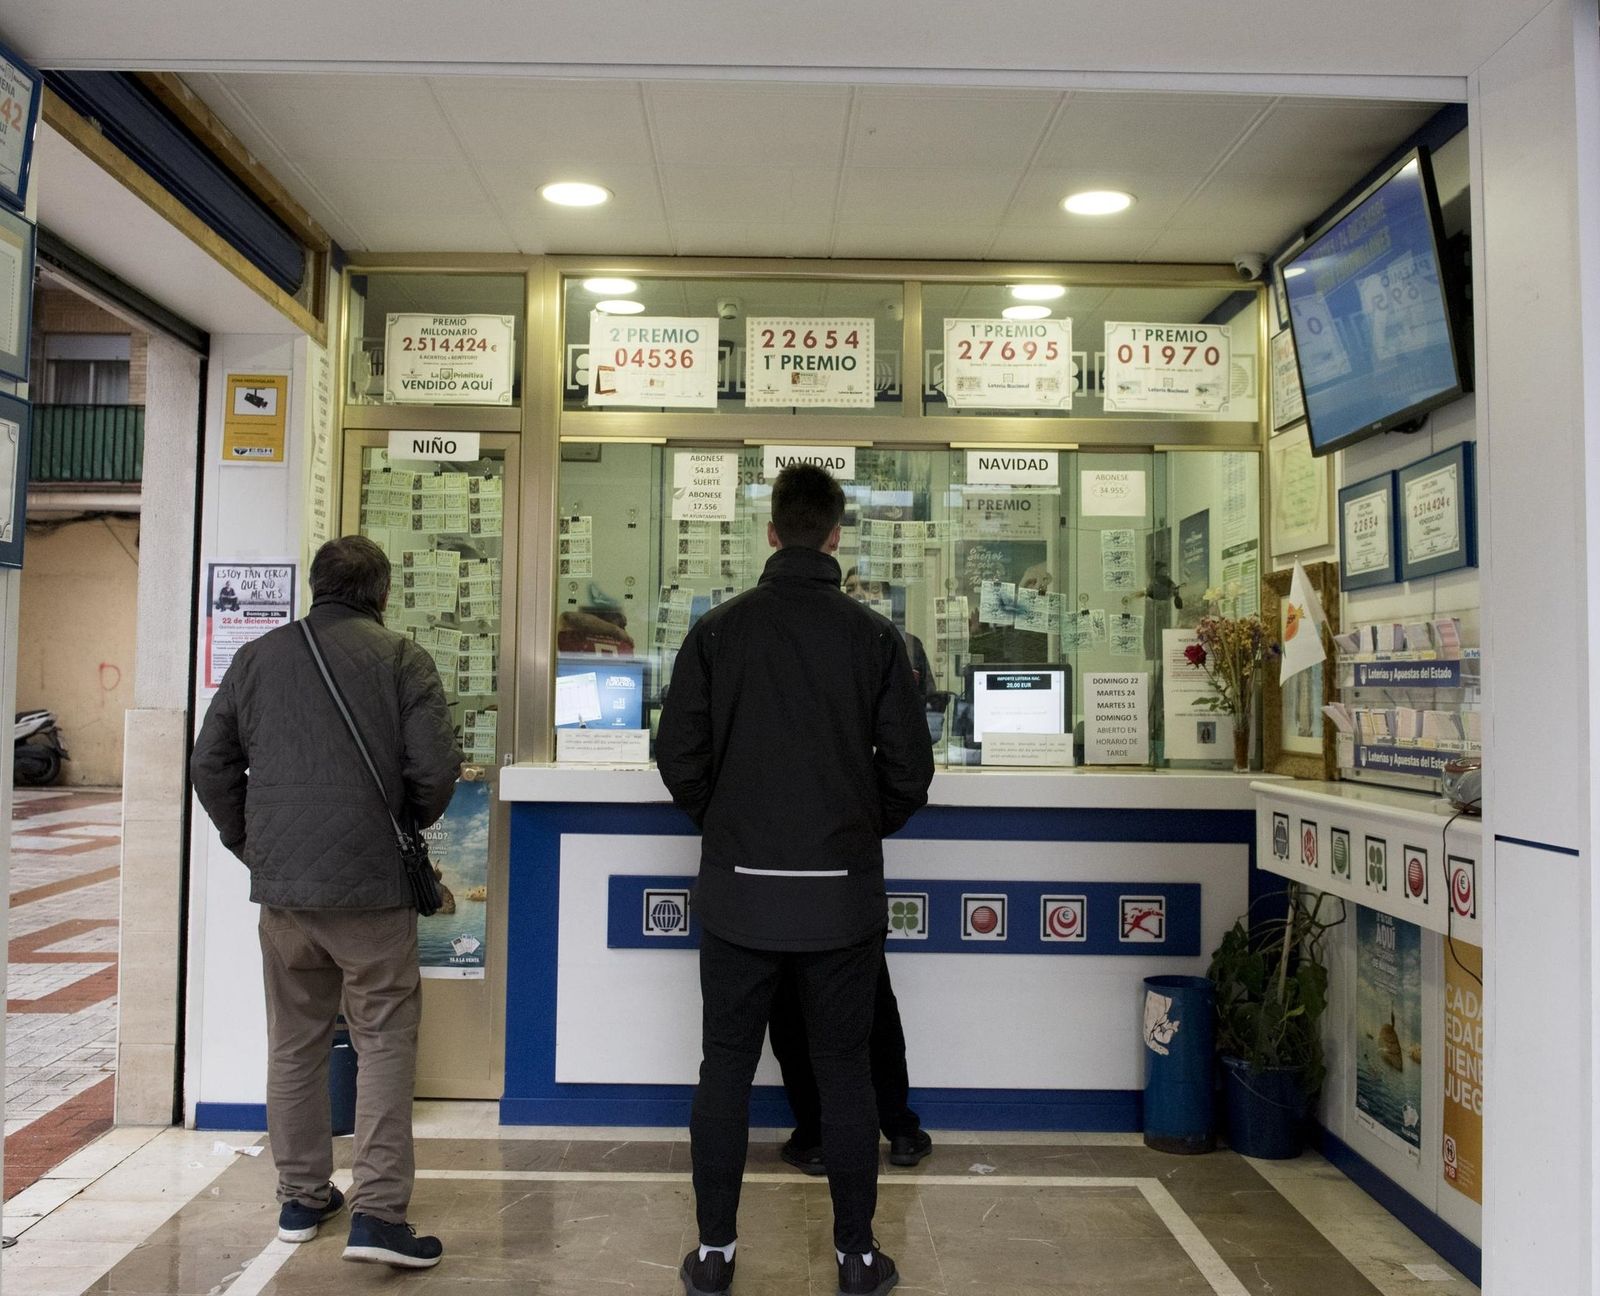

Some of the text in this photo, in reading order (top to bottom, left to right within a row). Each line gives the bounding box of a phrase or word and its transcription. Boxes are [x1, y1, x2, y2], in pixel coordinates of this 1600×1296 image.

[628, 328, 700, 343] PREMIO
[761, 329, 859, 349] 22654
[984, 325, 1047, 338] PREMIO
[1146, 329, 1207, 343] PREMIO
[402, 336, 487, 352] 2.514.424
[958, 340, 1058, 360] 27695
[615, 348, 694, 368] 04536
[1118, 344, 1220, 366] 01970
[781, 355, 856, 371] PREMIO
[402, 378, 493, 390] VENDIDO AQUÍ
[413, 436, 457, 454] NIÑO
[776, 456, 845, 470] NAVIDAD
[979, 458, 1048, 470] NAVIDAD
[978, 500, 1031, 511] PREMIO
[216, 569, 288, 579] ESTOY TAN CERCA
[241, 580, 275, 590] QUE NO
[251, 588, 283, 599] ME VES
[1368, 668, 1389, 679] Loterías
[1394, 668, 1420, 682] Apuestas
[1421, 667, 1430, 679] del
[1431, 667, 1452, 679] Estado
[1368, 751, 1389, 763] Loterías
[1394, 753, 1420, 768] Apuestas
[1420, 756, 1430, 768] del
[1431, 757, 1449, 769] Estad
[1376, 922, 1395, 950] AQUÍ
